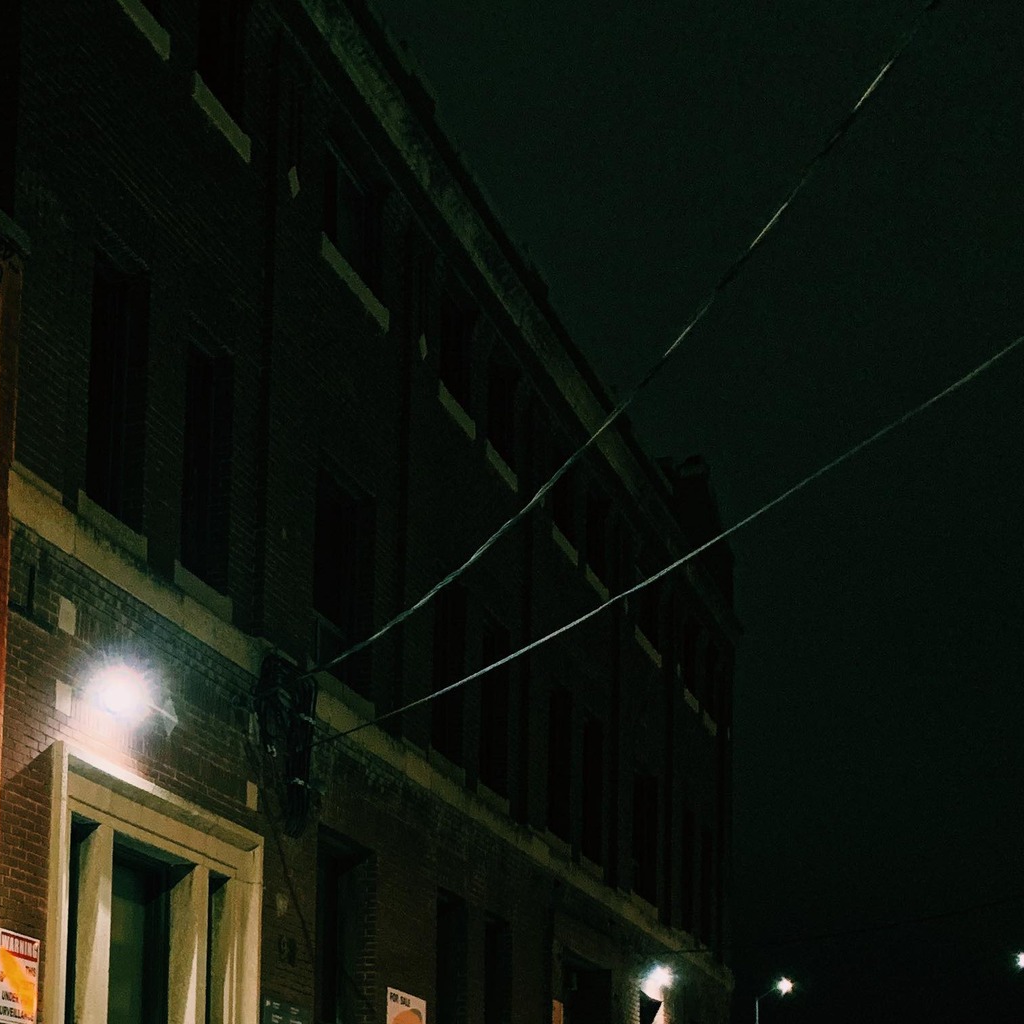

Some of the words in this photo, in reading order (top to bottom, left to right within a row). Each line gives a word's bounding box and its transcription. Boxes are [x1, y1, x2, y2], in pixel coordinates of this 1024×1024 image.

[1, 934, 38, 959] WARNING
[389, 991, 399, 1004] FOR
[400, 996, 411, 1008] SALE
